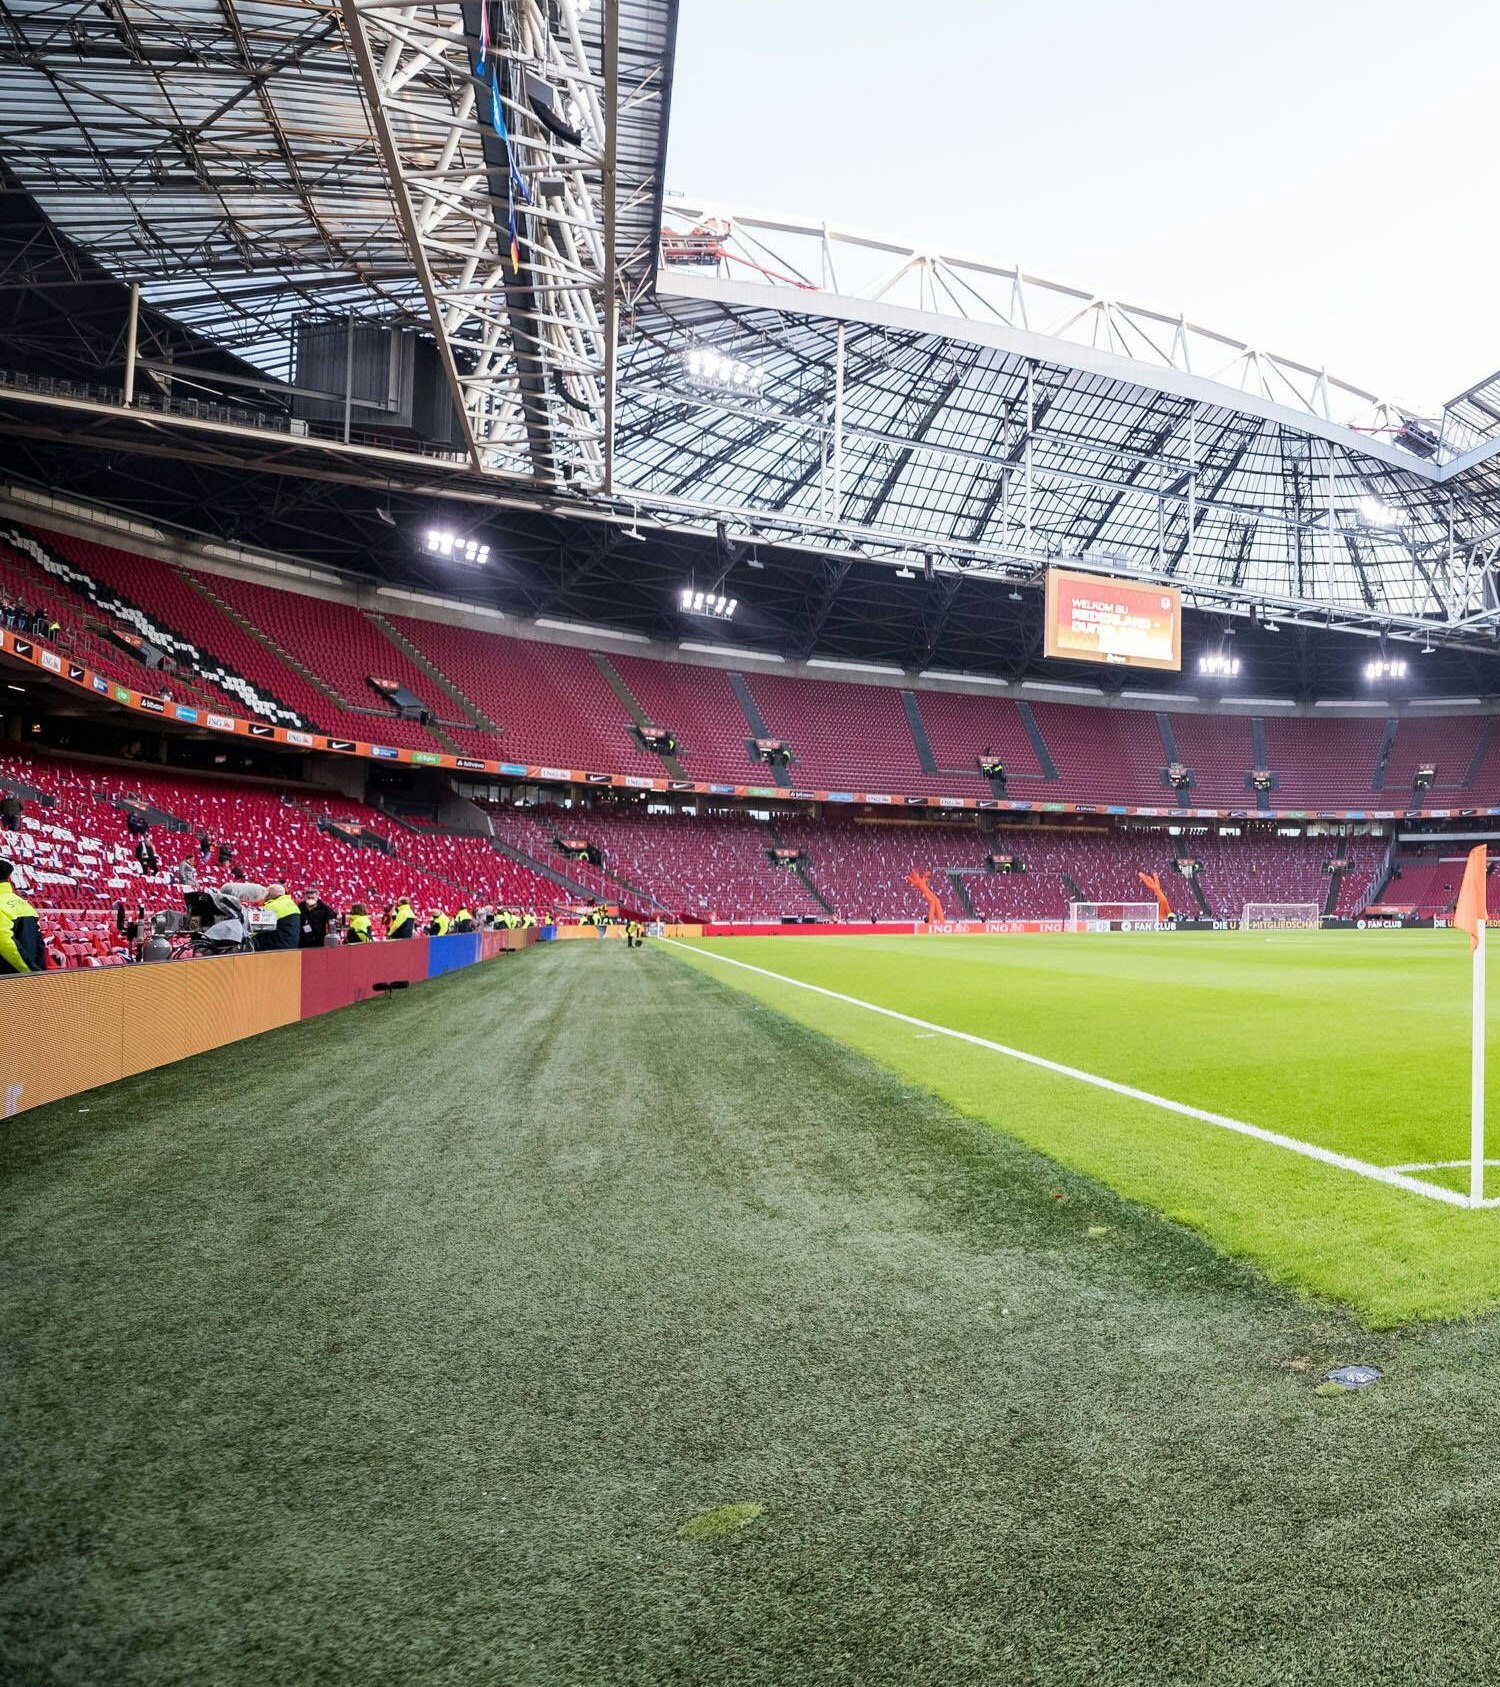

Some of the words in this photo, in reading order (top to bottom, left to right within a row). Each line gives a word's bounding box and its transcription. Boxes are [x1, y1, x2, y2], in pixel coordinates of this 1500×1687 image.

[1072, 598, 1113, 613] WELKOM
[985, 924, 1009, 933] ING
[1039, 923, 1062, 933] ING
[1134, 921, 1152, 931] FAN
[1154, 921, 1177, 931] CLUB
[1213, 920, 1228, 930] DIE
[1229, 921, 1237, 930] U
[1367, 919, 1382, 929] FAN
[1383, 919, 1402, 929] CLUB
[1434, 919, 1447, 929] DIE
[928, 925, 952, 934] ING
